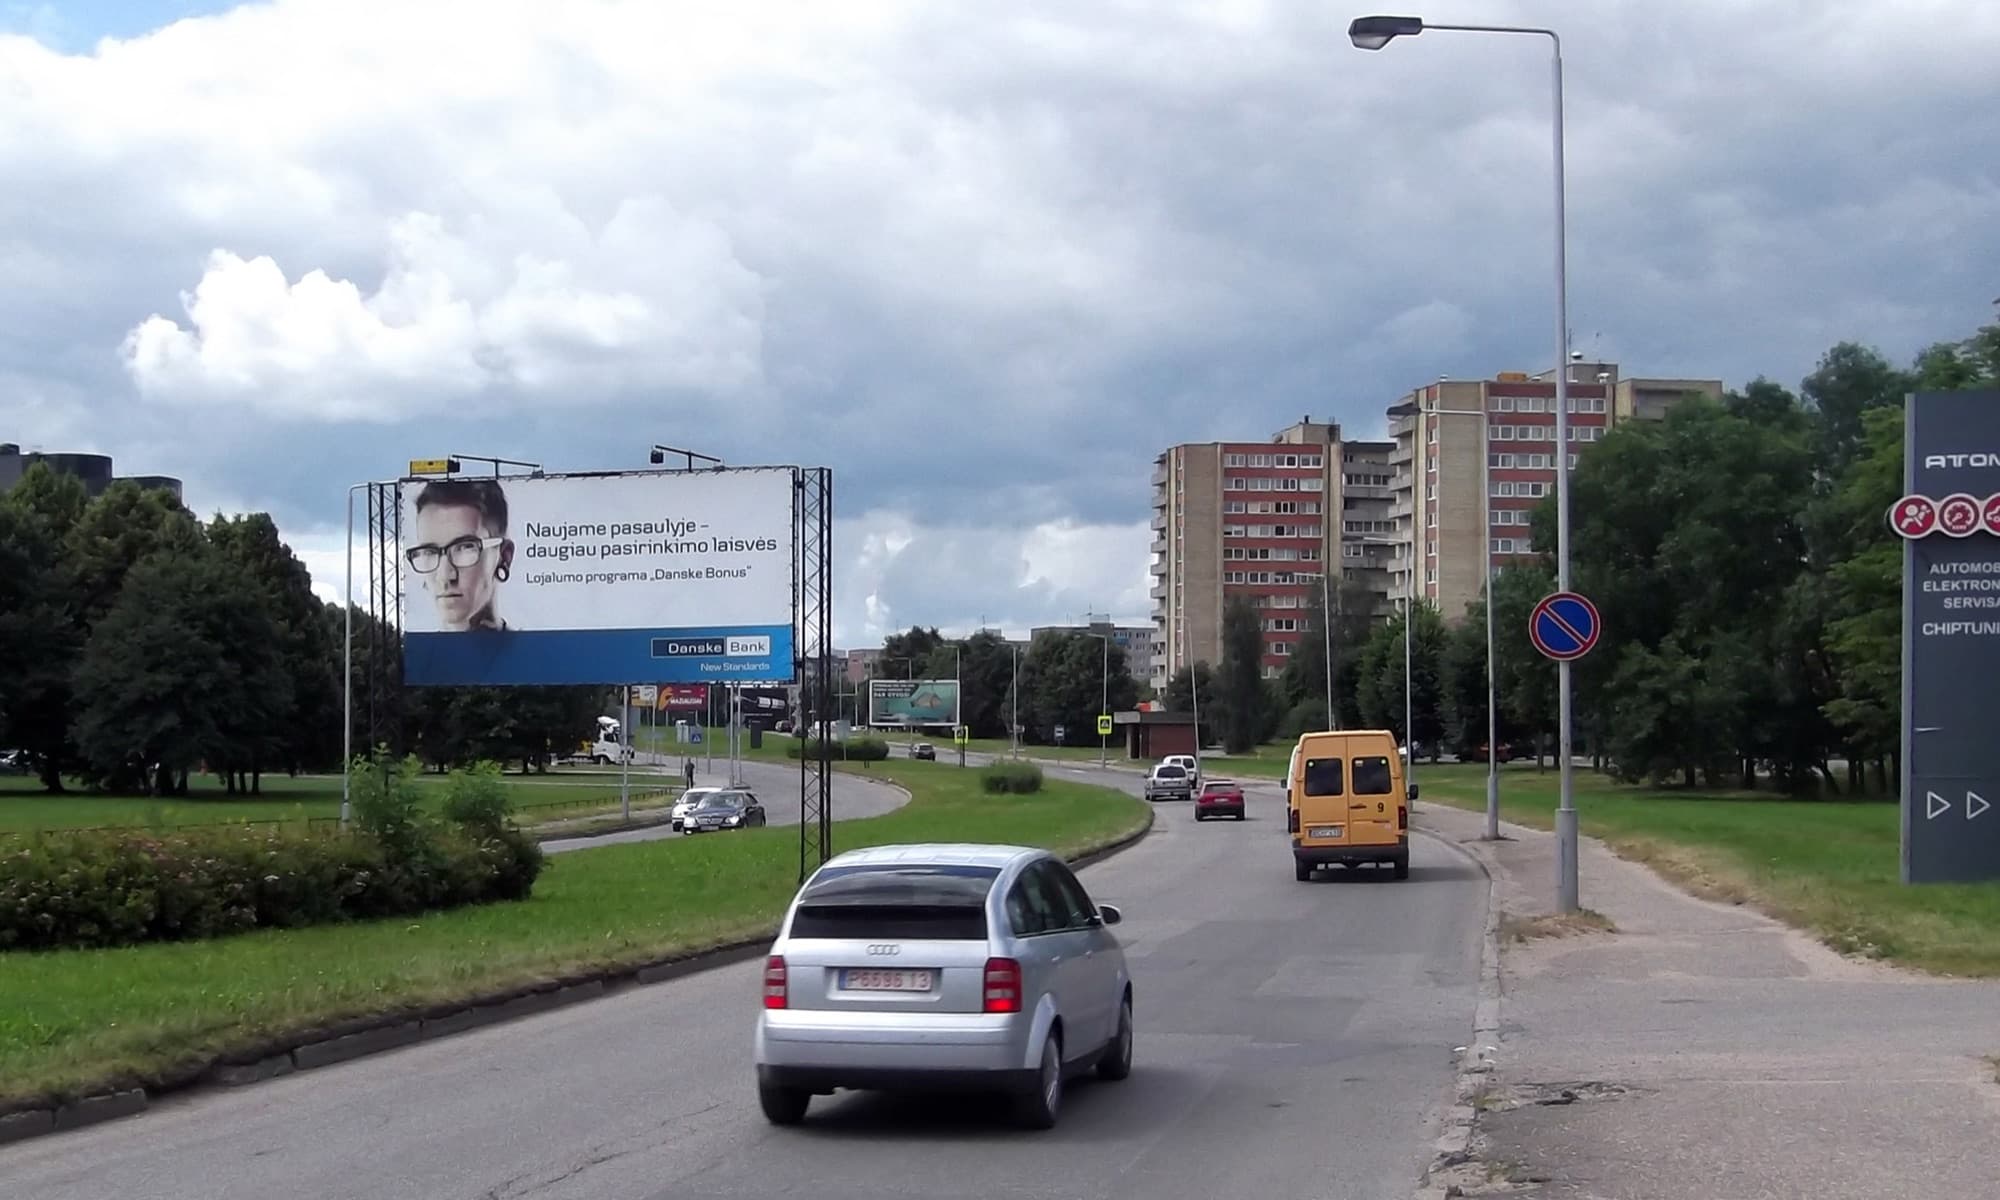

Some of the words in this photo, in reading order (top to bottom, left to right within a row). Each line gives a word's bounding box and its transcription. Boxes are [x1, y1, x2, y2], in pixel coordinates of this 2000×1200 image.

[526, 521, 607, 541] Naujame
[611, 518, 697, 539] pasaulyje
[525, 542, 597, 561] daugiau
[600, 539, 709, 560] pasirinkimo
[712, 536, 777, 553] laisvės
[525, 571, 584, 586] Lojalumo
[585, 570, 648, 585] programa
[668, 642, 722, 655] Danske
[730, 641, 766, 653] Bank
[700, 663, 721, 672] New
[723, 662, 770, 672] Standards
[1377, 802, 1385, 813] 9
